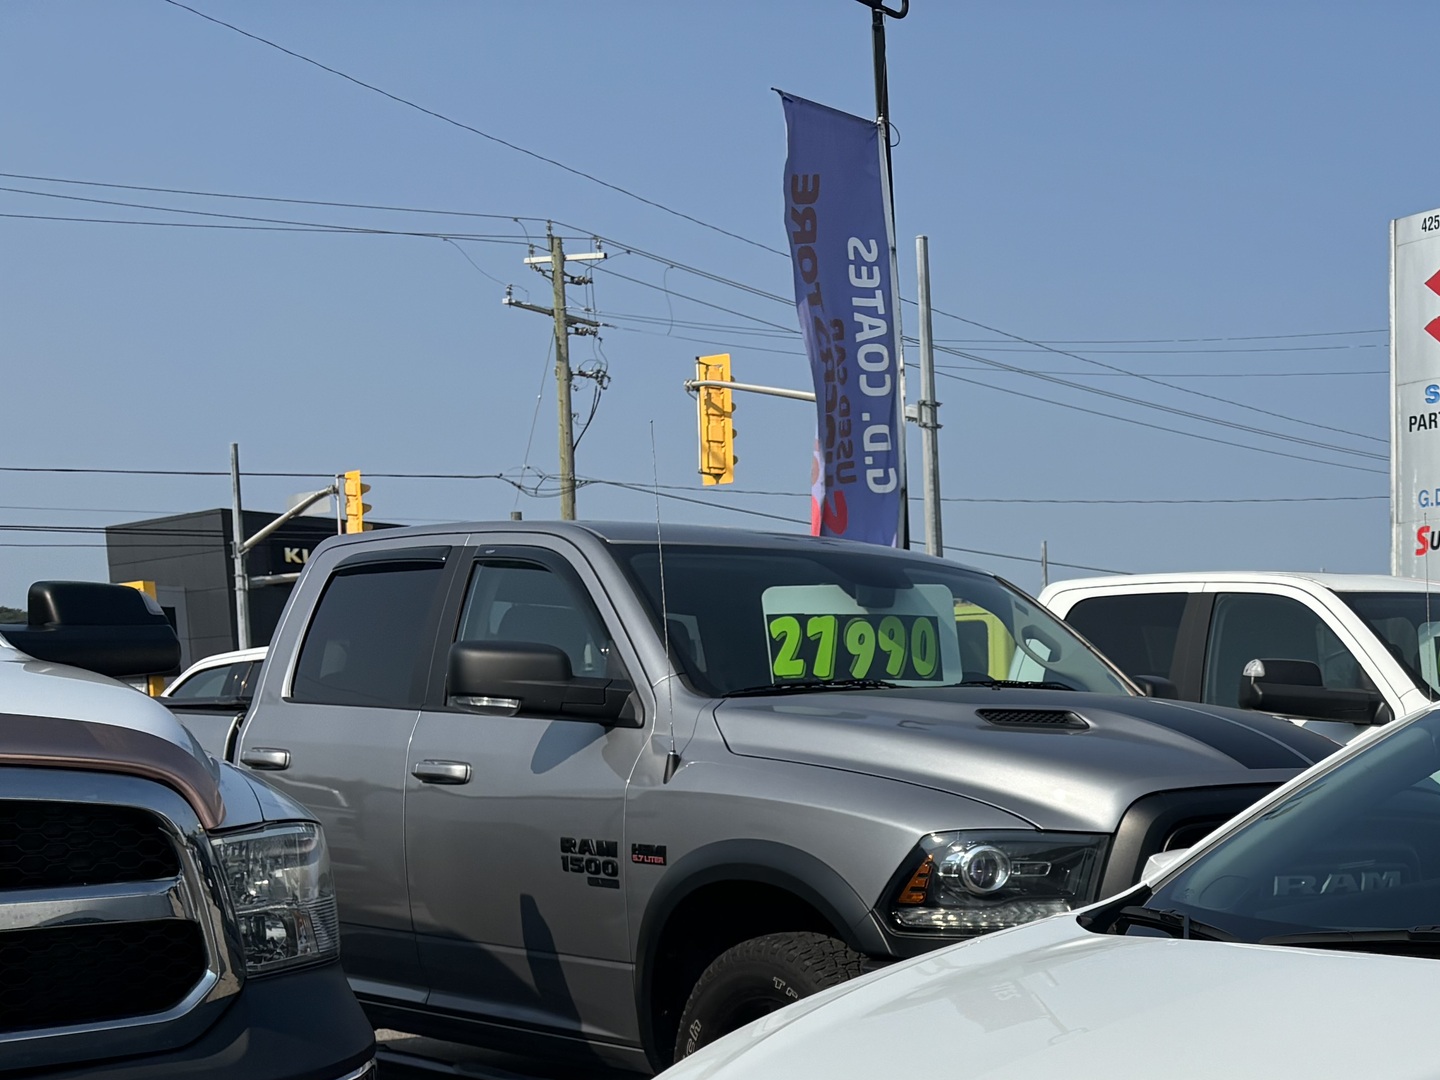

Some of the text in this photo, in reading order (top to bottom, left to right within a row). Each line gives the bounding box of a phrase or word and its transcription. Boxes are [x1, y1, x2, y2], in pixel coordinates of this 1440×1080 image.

[1421, 213, 1440, 233] 425
[284, 547, 310, 564] KI
[769, 615, 938, 680] 27990
[560, 837, 618, 858] RAM
[561, 855, 619, 877] 1500
[1273, 871, 1400, 896] RAM
